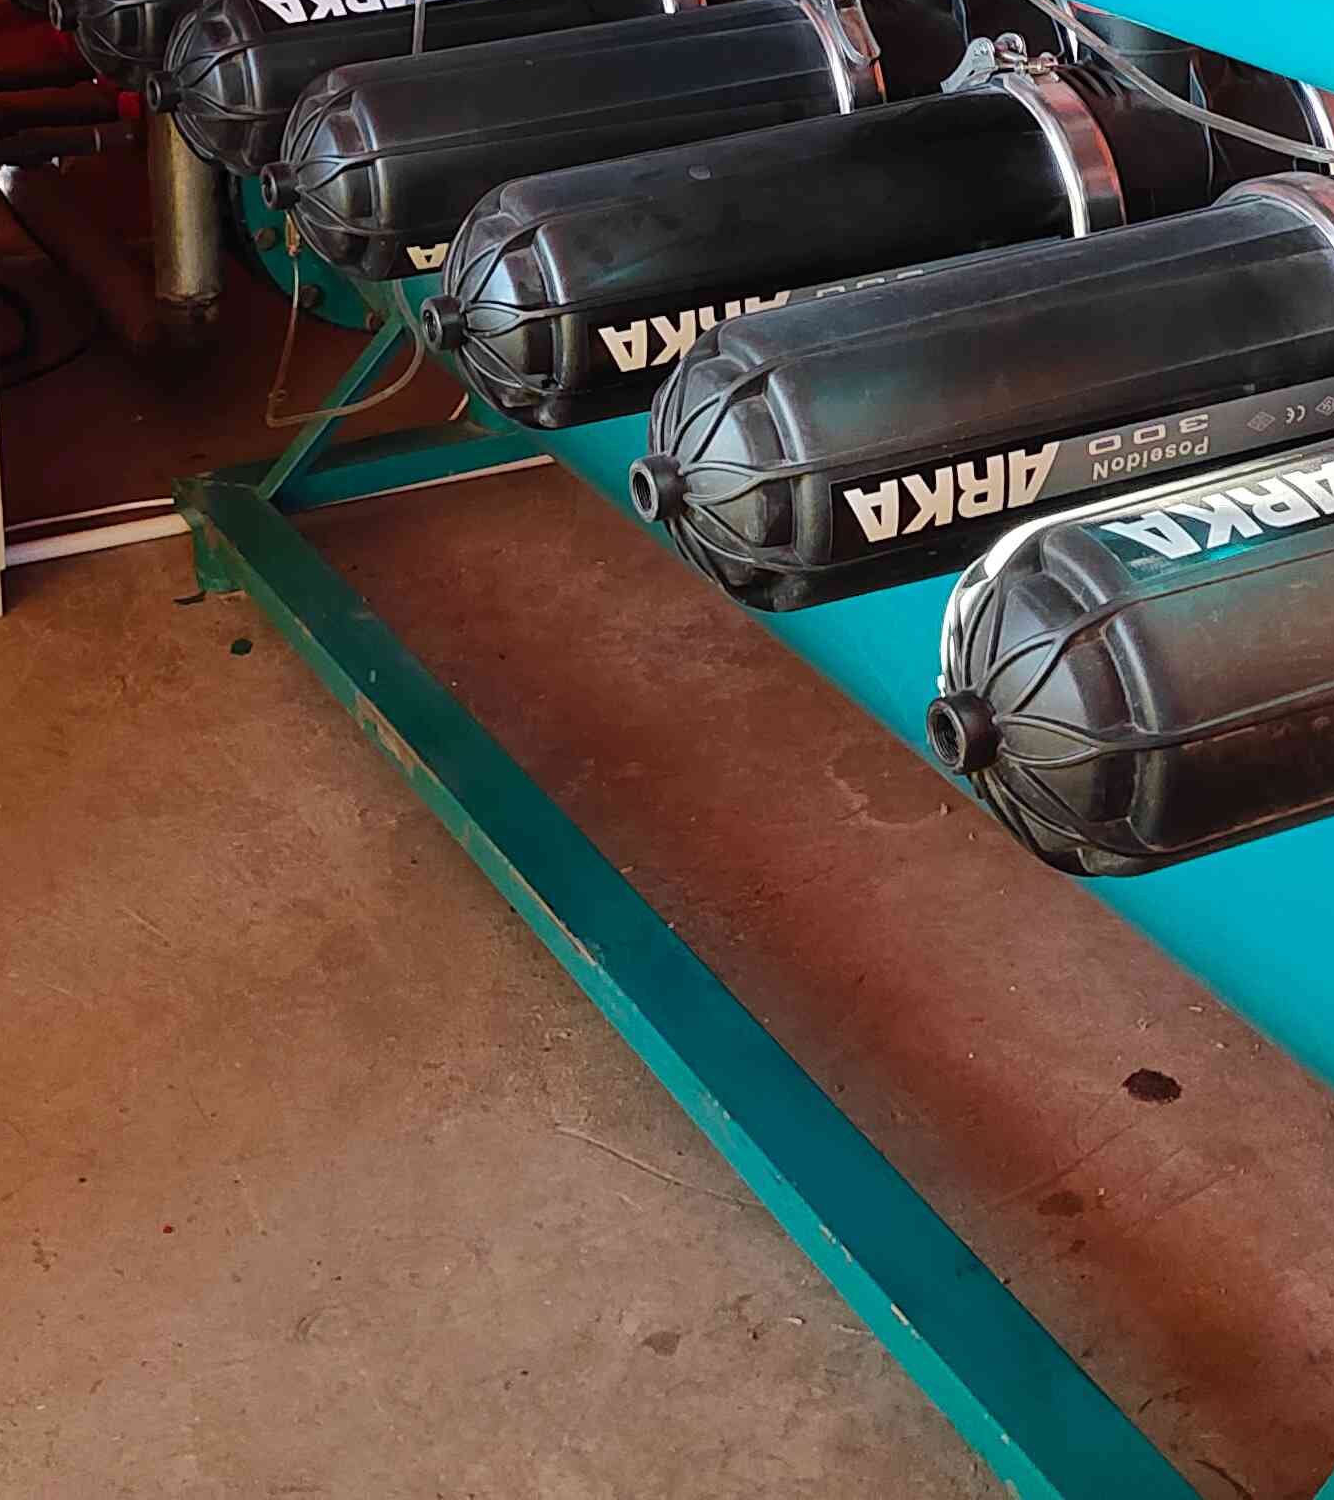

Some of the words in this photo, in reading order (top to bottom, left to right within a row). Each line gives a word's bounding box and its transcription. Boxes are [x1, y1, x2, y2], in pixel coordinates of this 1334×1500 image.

[1088, 414, 1210, 455] 300
[1092, 437, 1210, 481] PoseidoN
[843, 441, 1060, 543] ARKA
